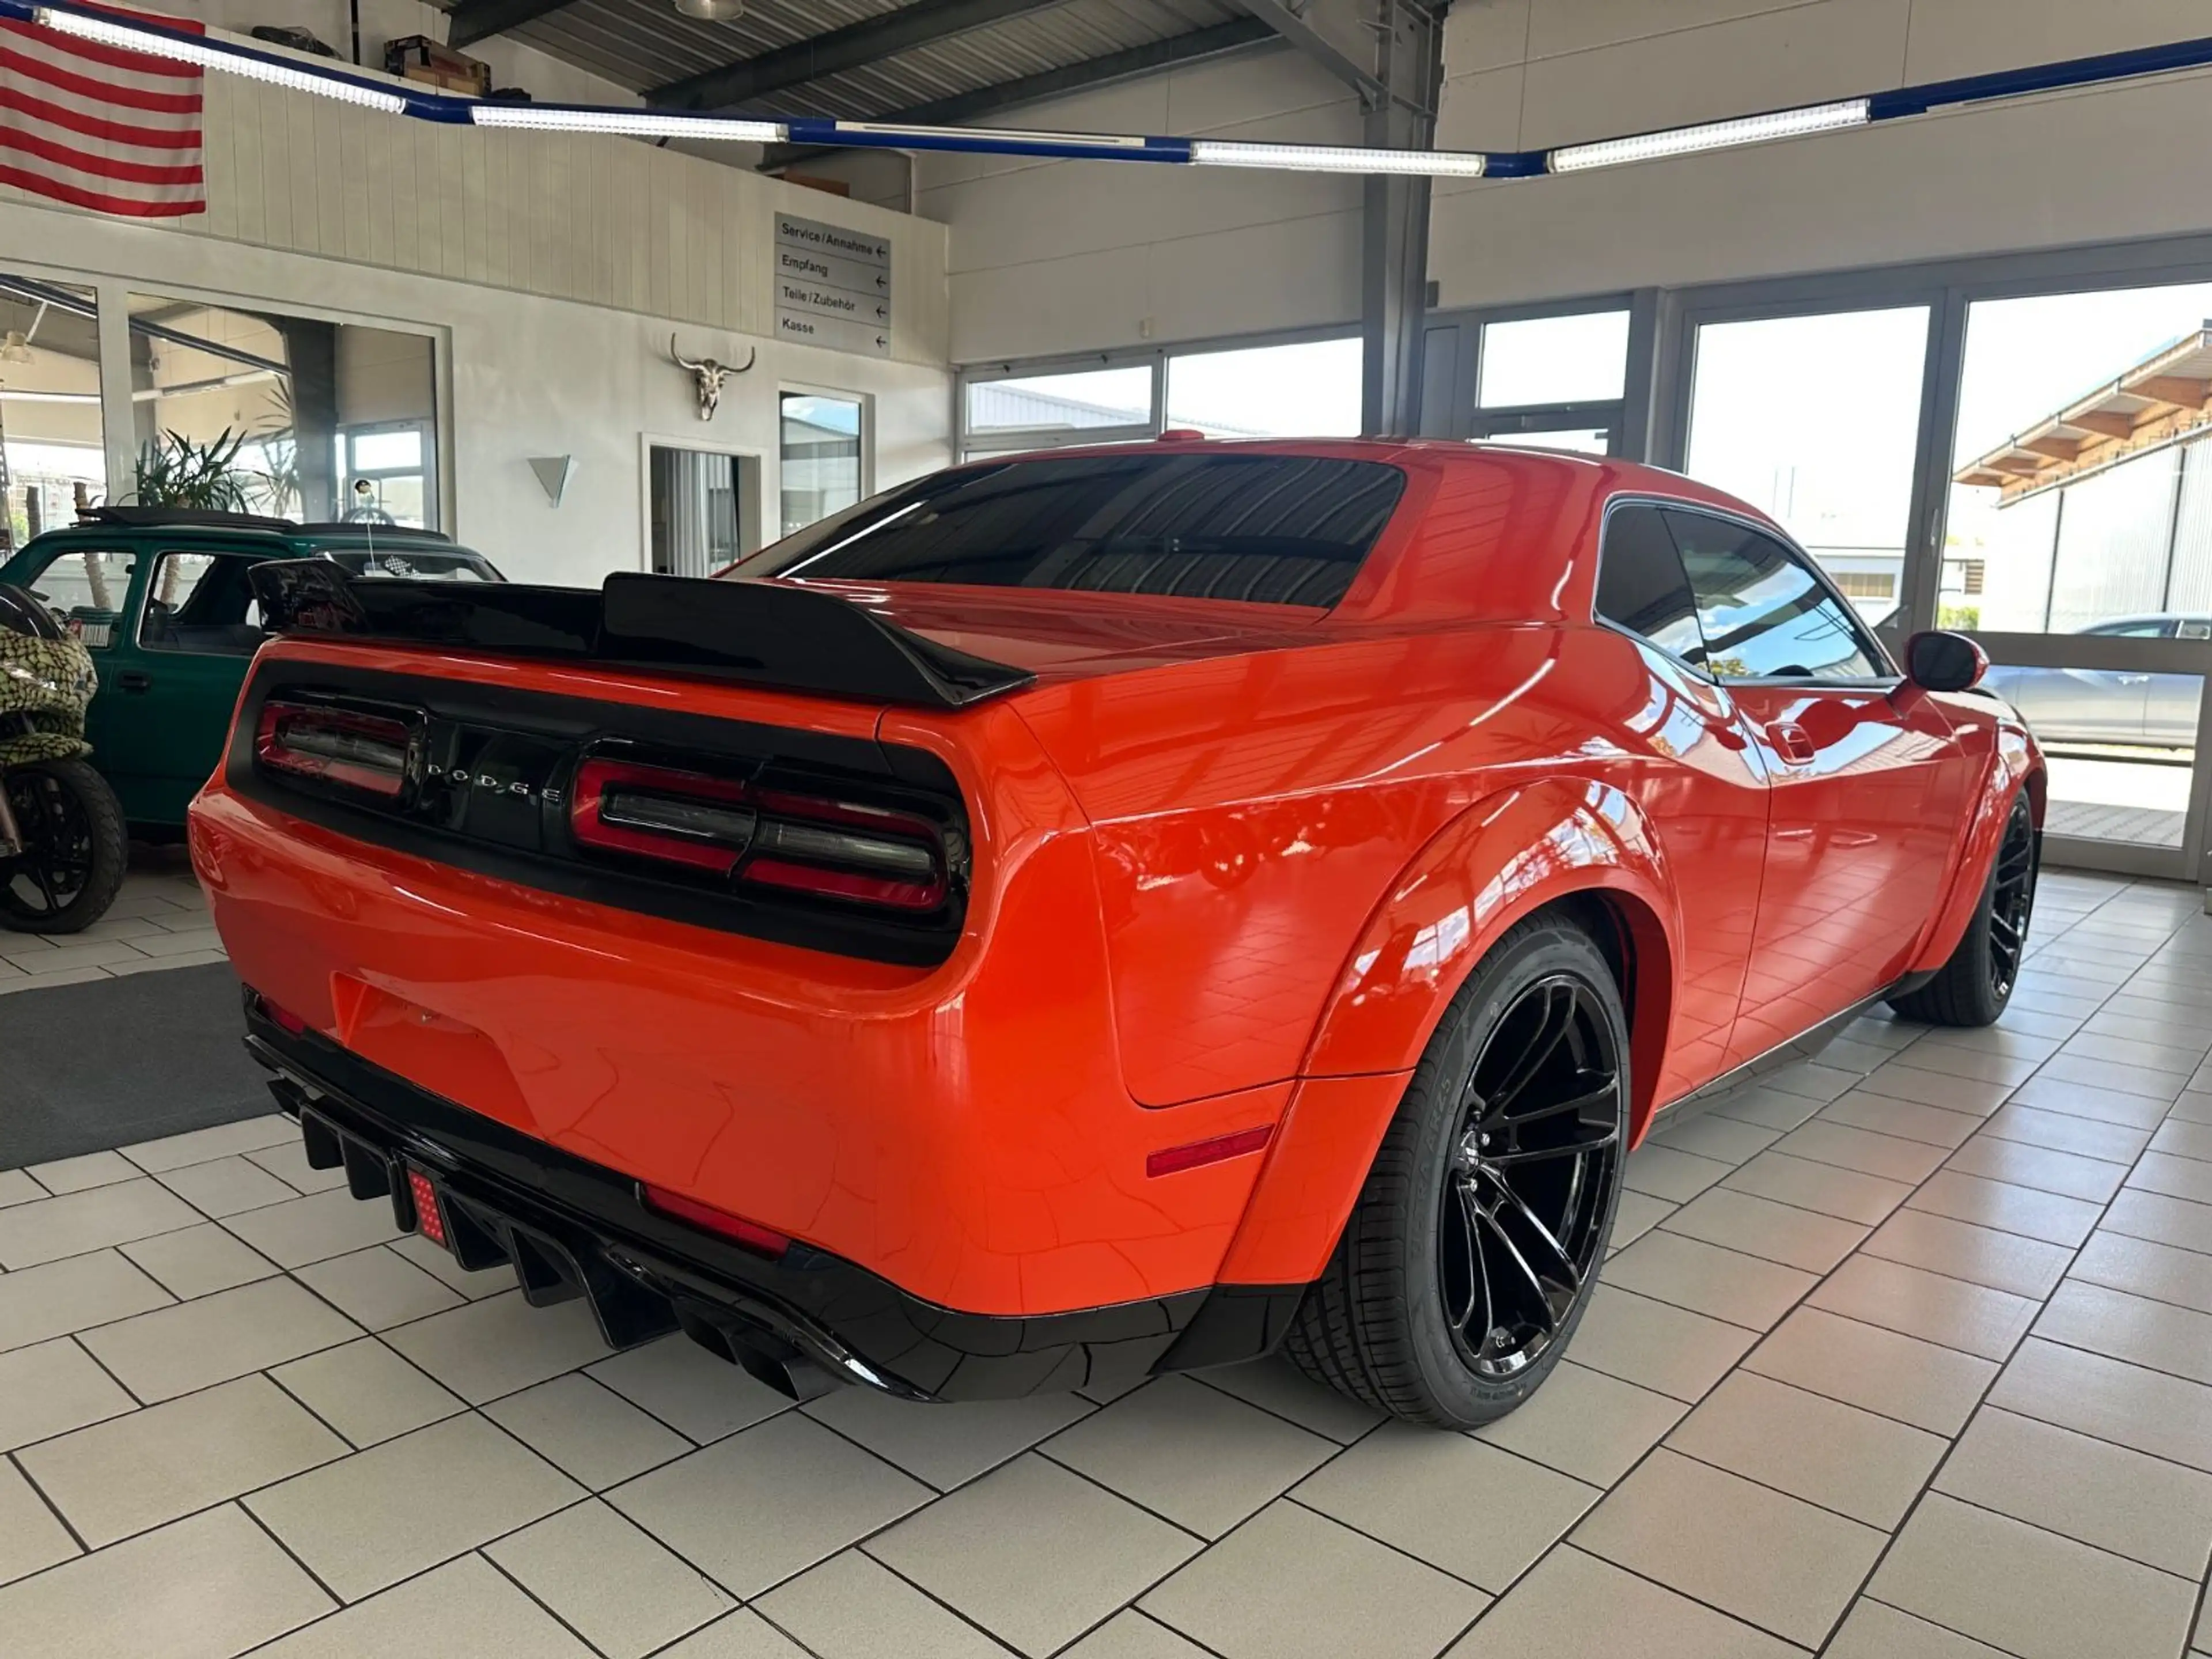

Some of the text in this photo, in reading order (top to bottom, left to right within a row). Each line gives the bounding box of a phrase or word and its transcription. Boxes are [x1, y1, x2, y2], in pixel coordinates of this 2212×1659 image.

[782, 254, 828, 278] Empfang
[782, 317, 815, 335] Kasse
[428, 764, 560, 801] DODGE
